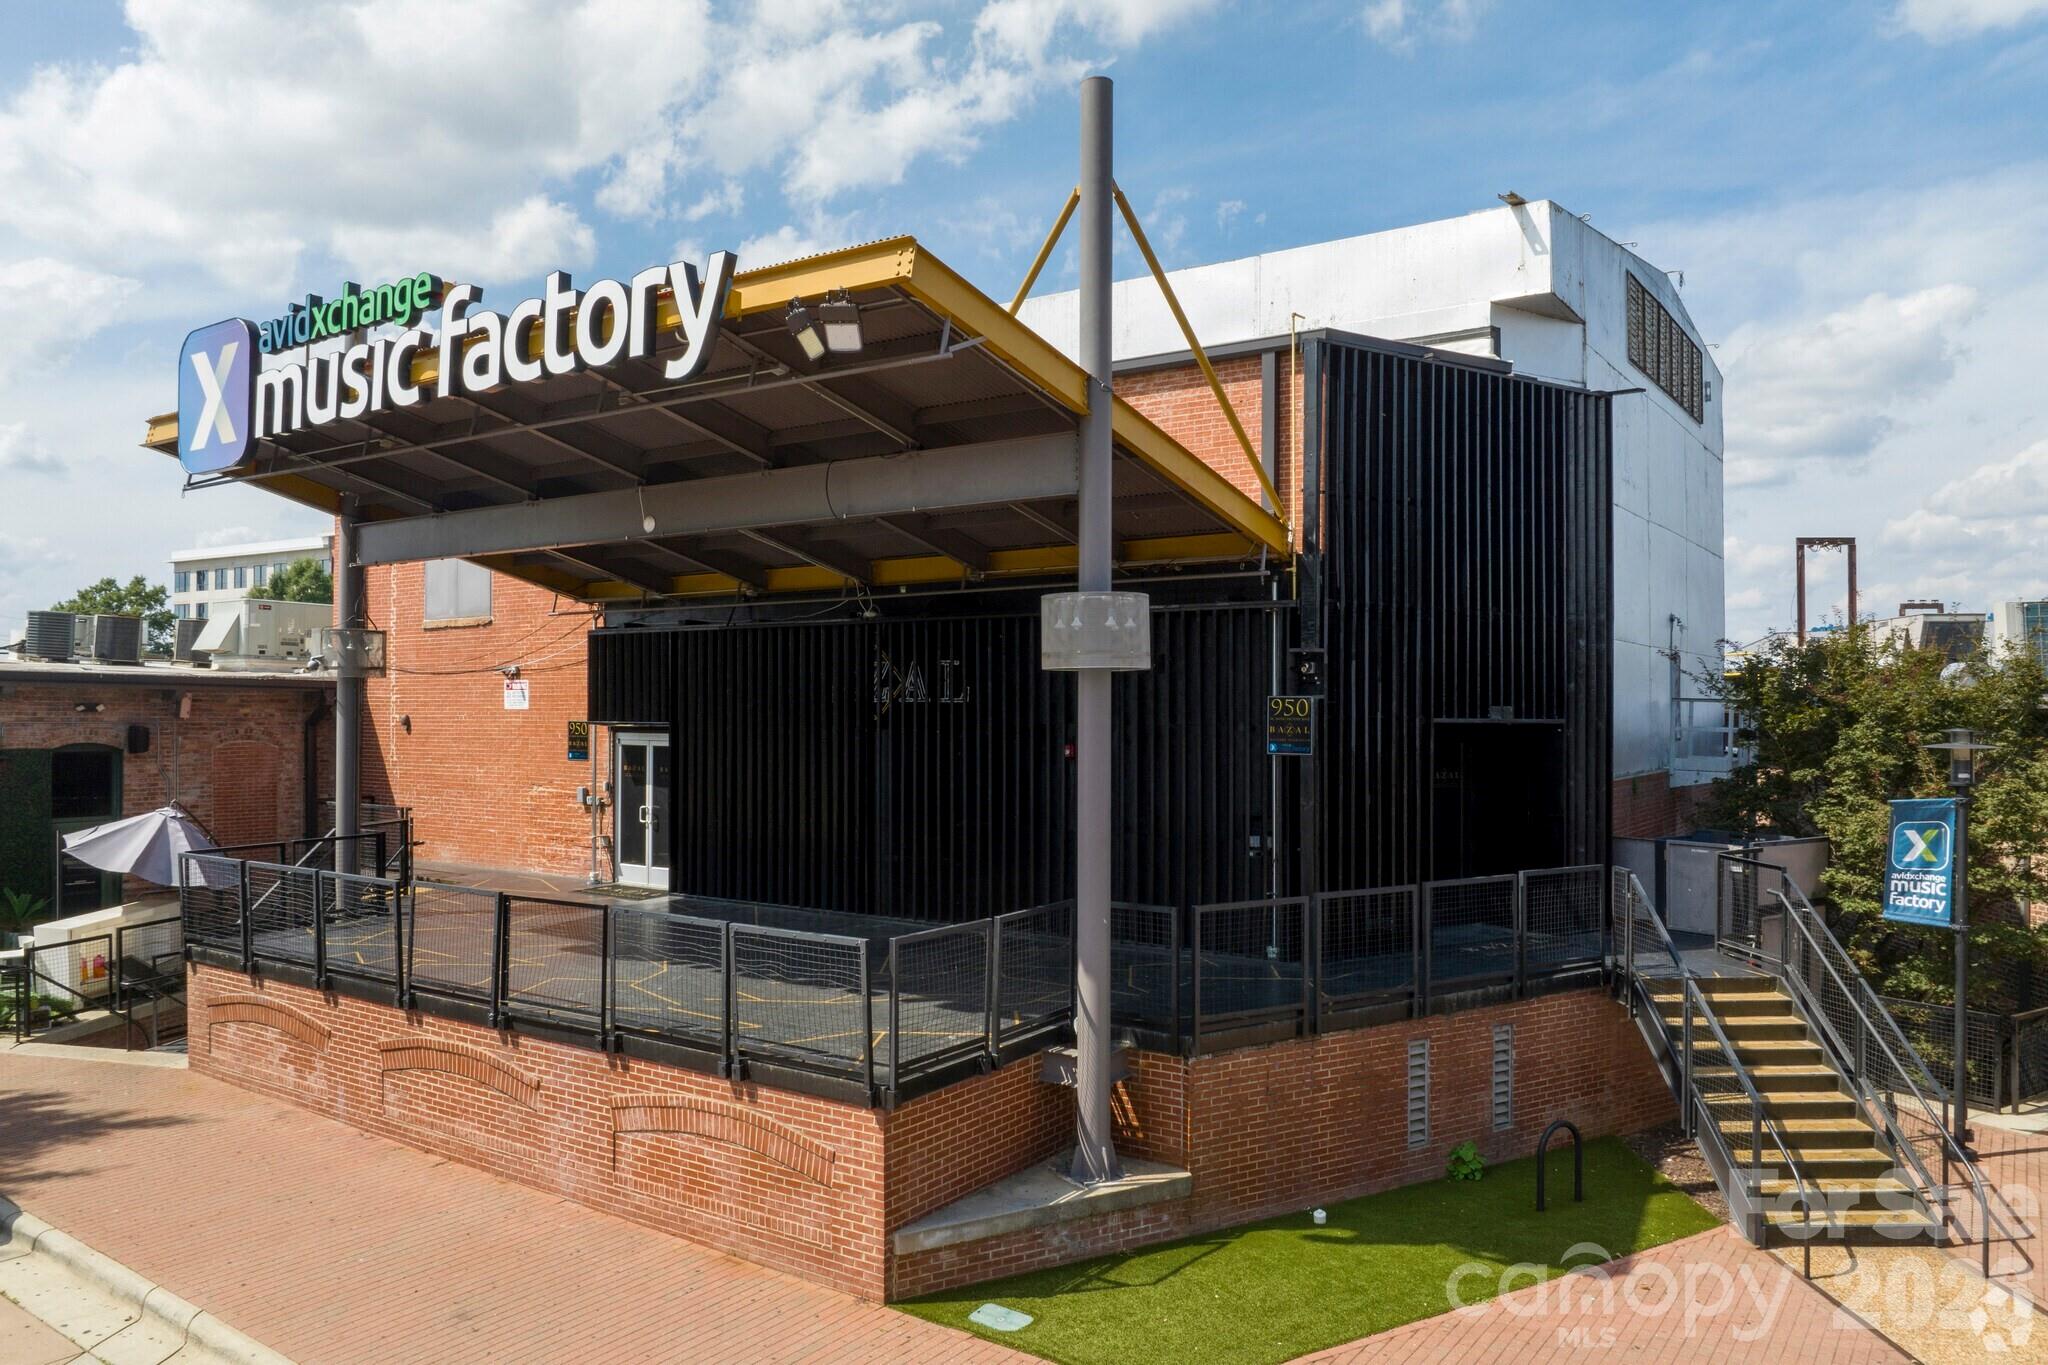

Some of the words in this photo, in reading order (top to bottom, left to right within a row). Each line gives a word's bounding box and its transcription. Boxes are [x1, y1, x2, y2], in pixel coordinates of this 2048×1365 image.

[258, 272, 432, 353] avidxchange
[255, 330, 425, 440] music
[437, 250, 733, 398] factory
[1271, 698, 1309, 717] 950
[569, 722, 588, 735] 950
[1891, 872, 1947, 883] avidxchange
[1890, 880, 1947, 896] music
[1889, 892, 1946, 913] factory
